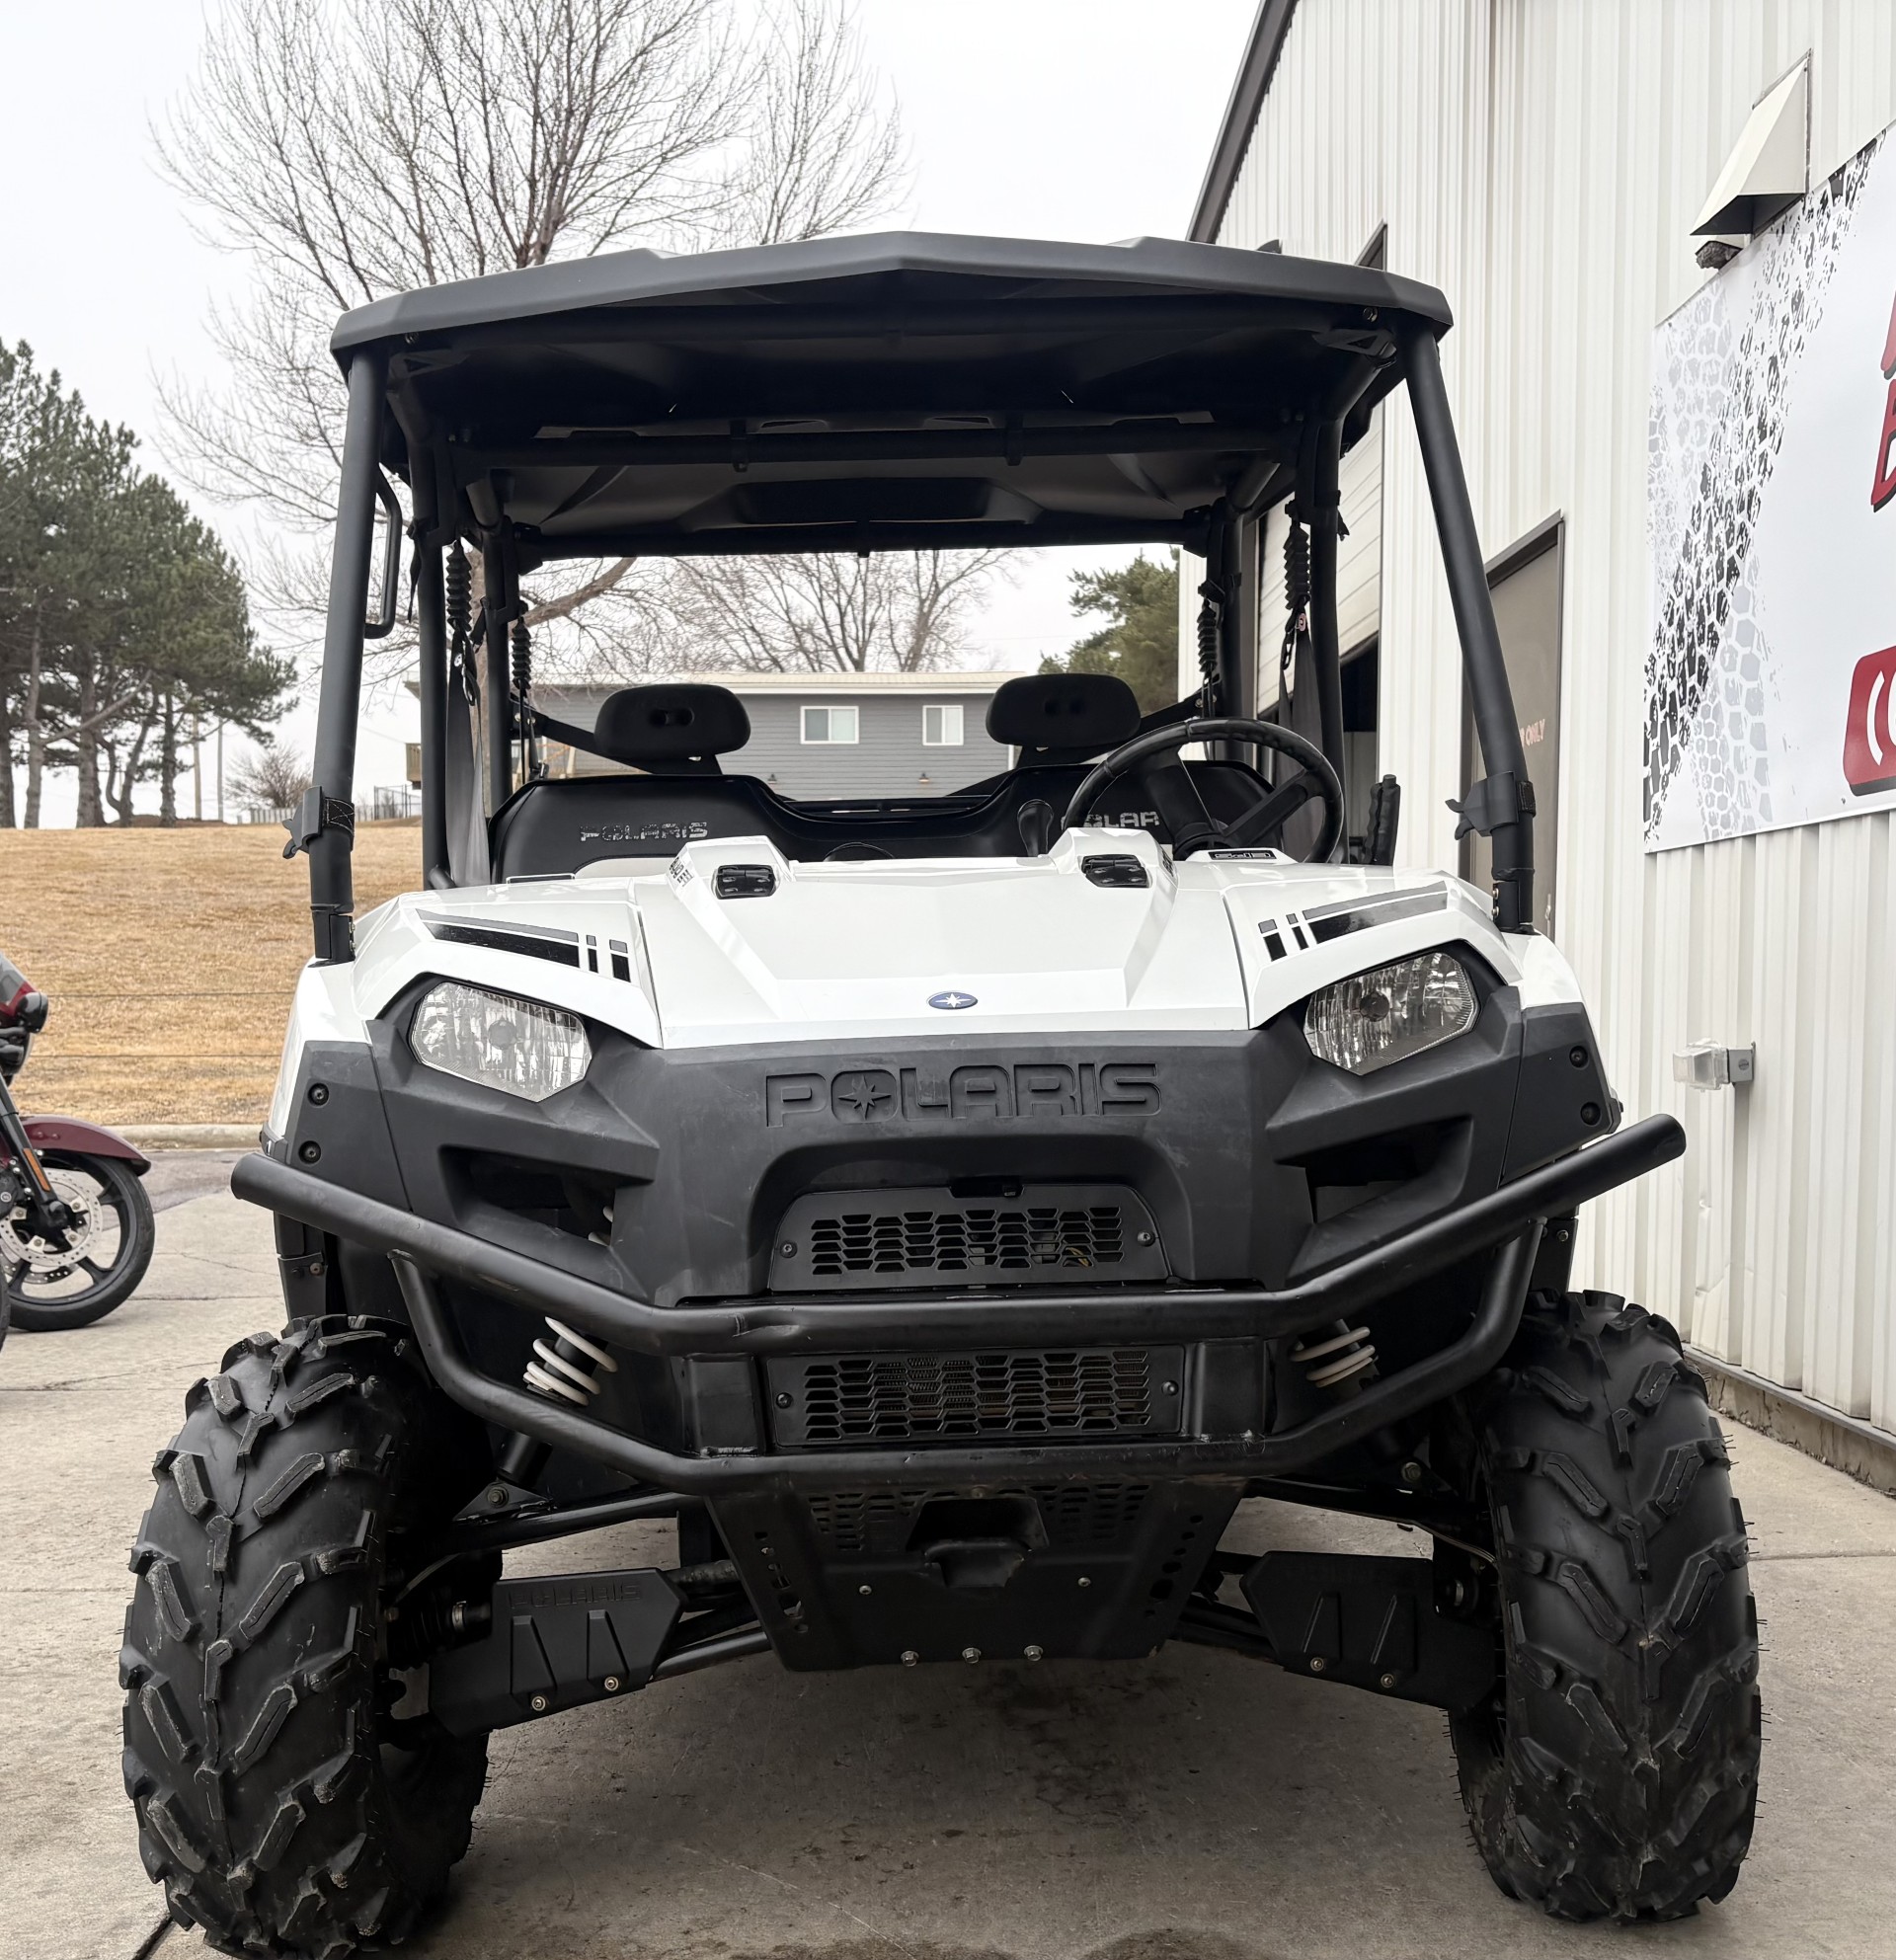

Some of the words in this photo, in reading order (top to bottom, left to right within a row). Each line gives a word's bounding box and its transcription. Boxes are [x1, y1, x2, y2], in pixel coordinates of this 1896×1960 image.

[1525, 718, 1546, 746] ONLY
[580, 822, 709, 842] POLARIS
[765, 1062, 1163, 1128] POLARIS
[508, 1580, 642, 1609] POLARIS
